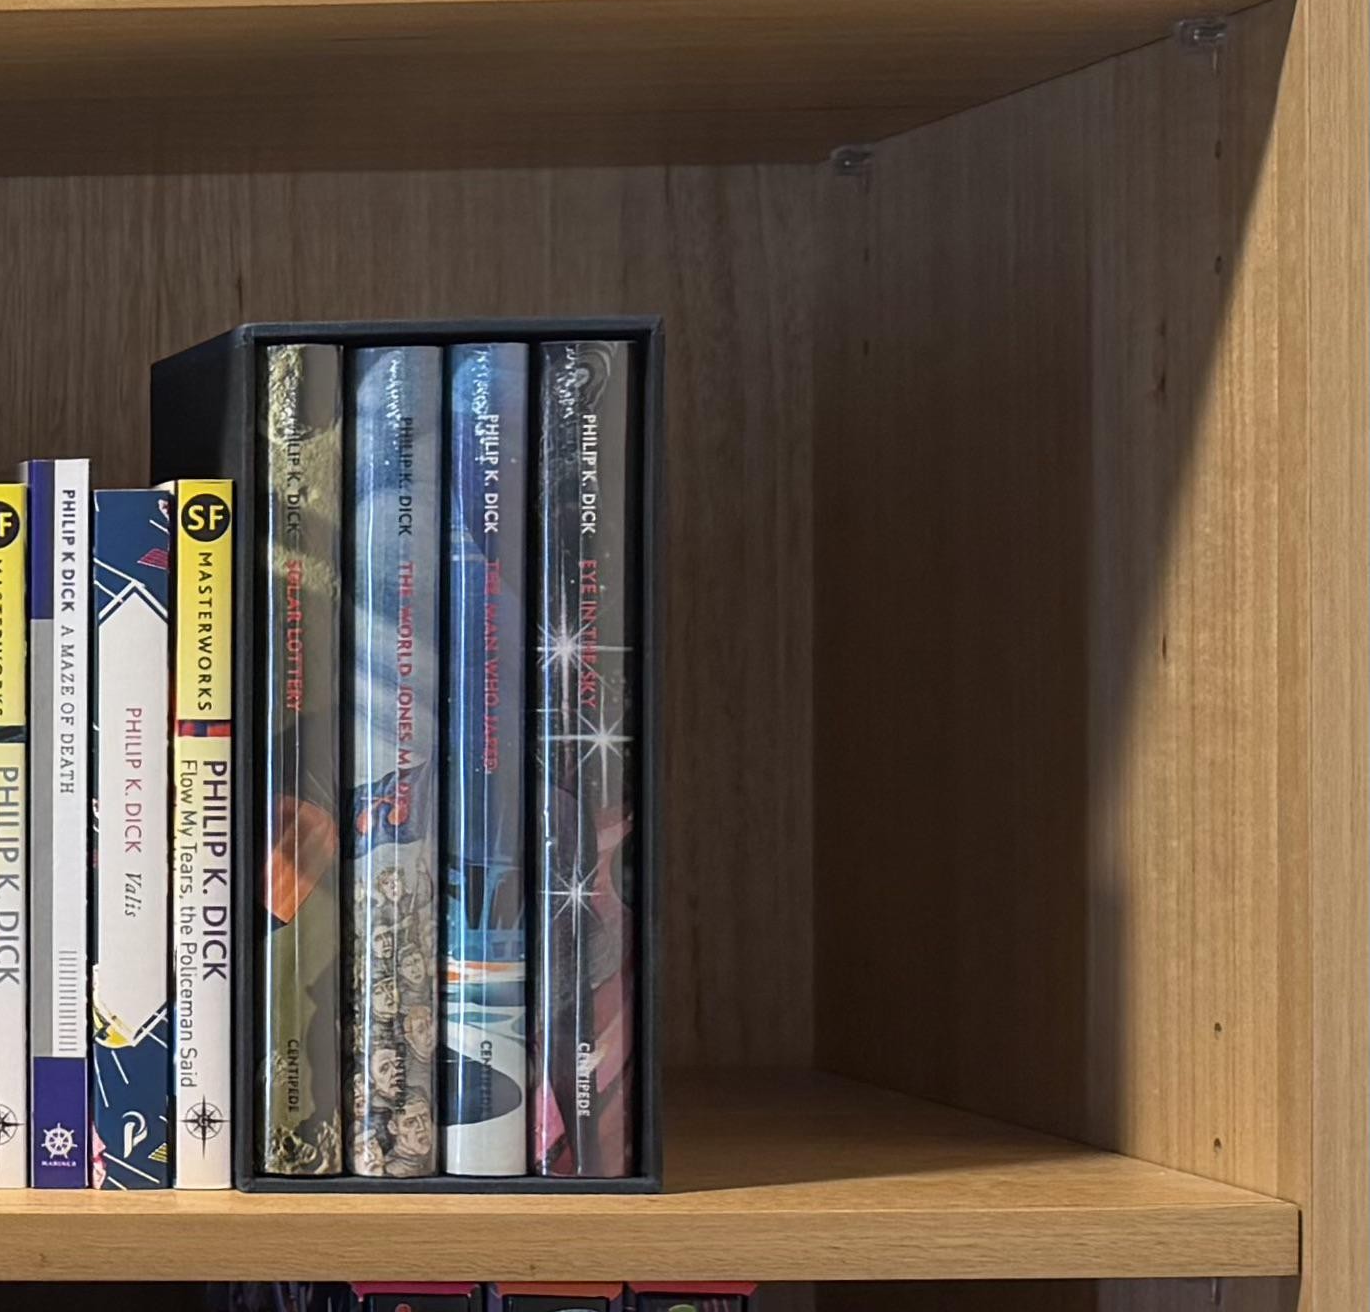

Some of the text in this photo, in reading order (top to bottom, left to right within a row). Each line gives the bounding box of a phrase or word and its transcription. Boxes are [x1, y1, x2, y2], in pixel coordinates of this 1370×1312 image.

[178, 760, 197, 1089] Flow My Tears, the Policeman Said
